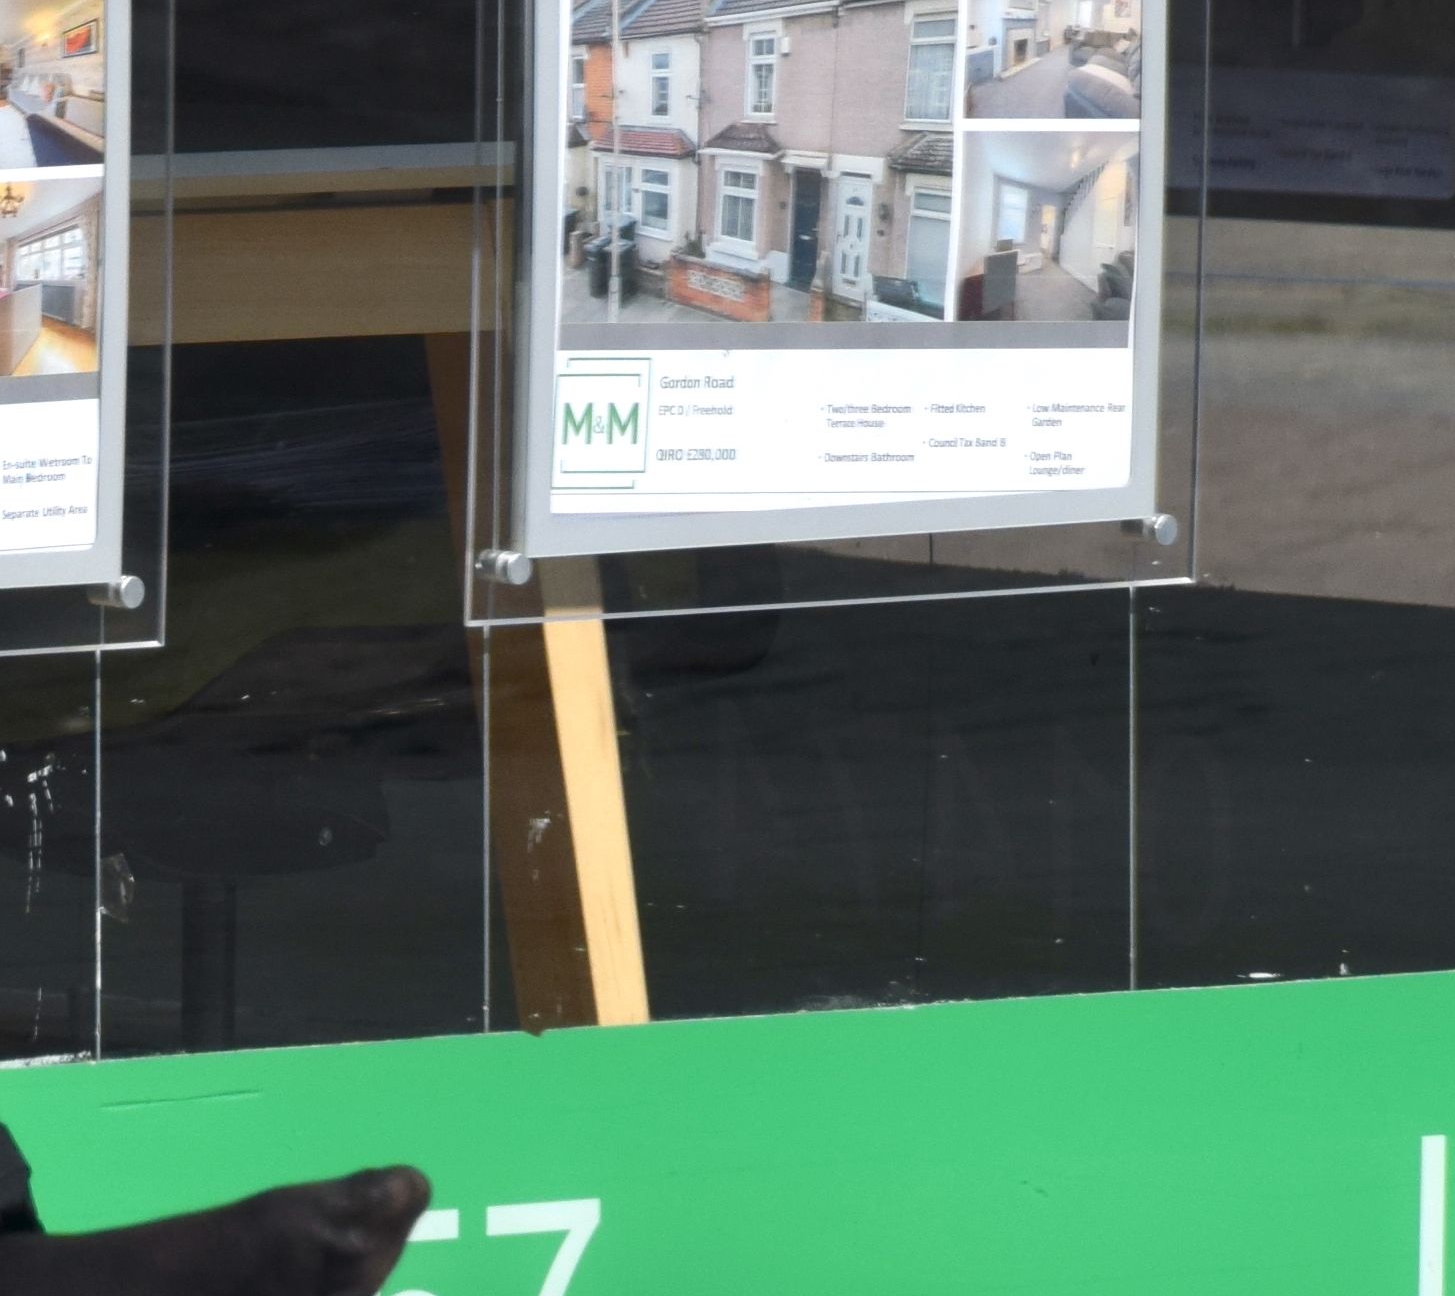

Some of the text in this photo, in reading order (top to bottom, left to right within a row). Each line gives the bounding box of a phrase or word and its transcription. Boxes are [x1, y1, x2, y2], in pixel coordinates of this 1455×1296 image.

[660, 376, 734, 389] Gordon Road
[693, 405, 733, 415] Freehold
[871, 404, 911, 414] Bedroom
[931, 404, 985, 413] Fitted Kitchen
[1033, 403, 1049, 413] Low
[1107, 403, 1125, 412] Rear
[562, 402, 639, 445] M&M
[1032, 417, 1062, 427] Garden
[929, 438, 957, 448] Council
[960, 438, 973, 447] Tax
[871, 453, 914, 462] Bathroom
[1030, 451, 1072, 461] Open Plan
[2, 507, 39, 520] Separate
